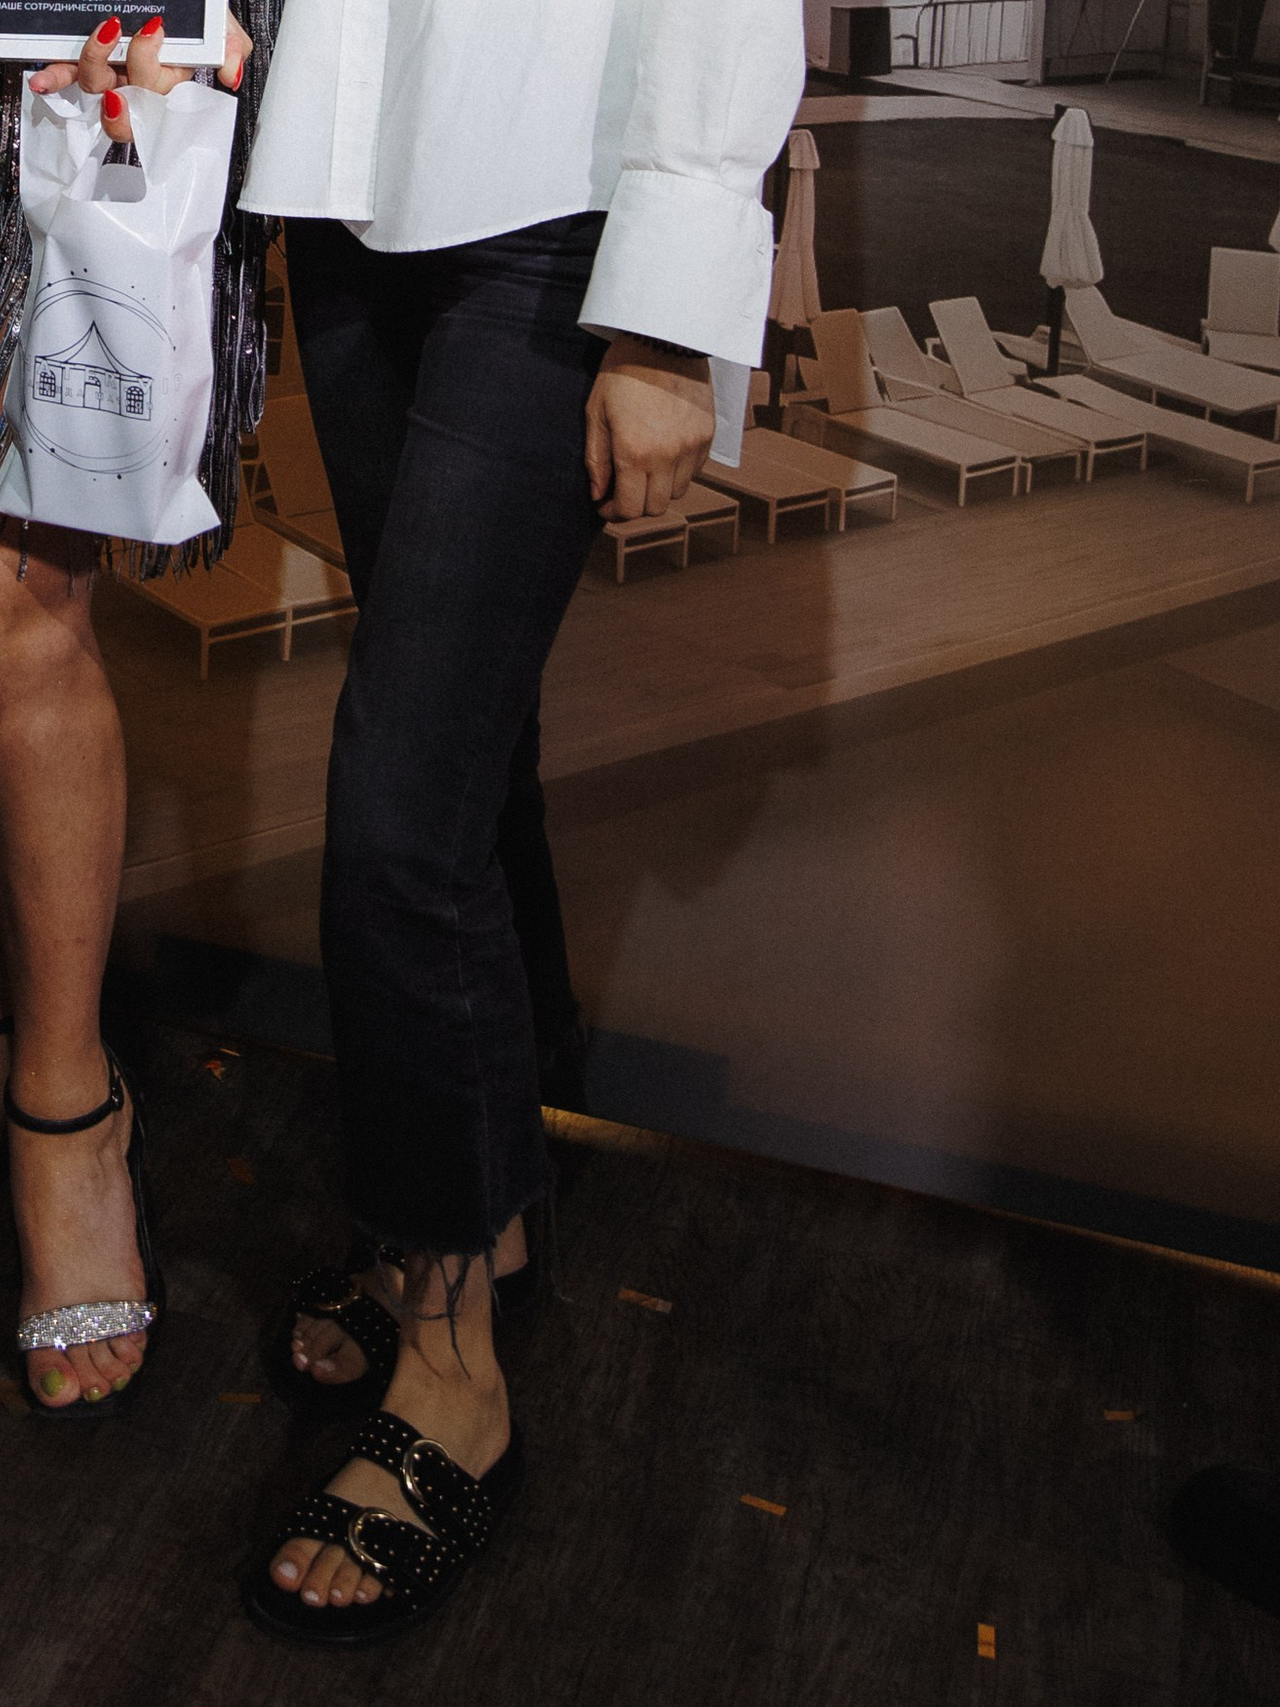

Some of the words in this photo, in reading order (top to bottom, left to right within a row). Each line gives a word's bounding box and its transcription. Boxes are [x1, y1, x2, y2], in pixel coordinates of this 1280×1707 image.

[23, 2, 112, 13] СОТРУДНИЧЕСТВО
[114, 4, 121, 13] И
[122, 4, 166, 14] ДРУЖБУ!
